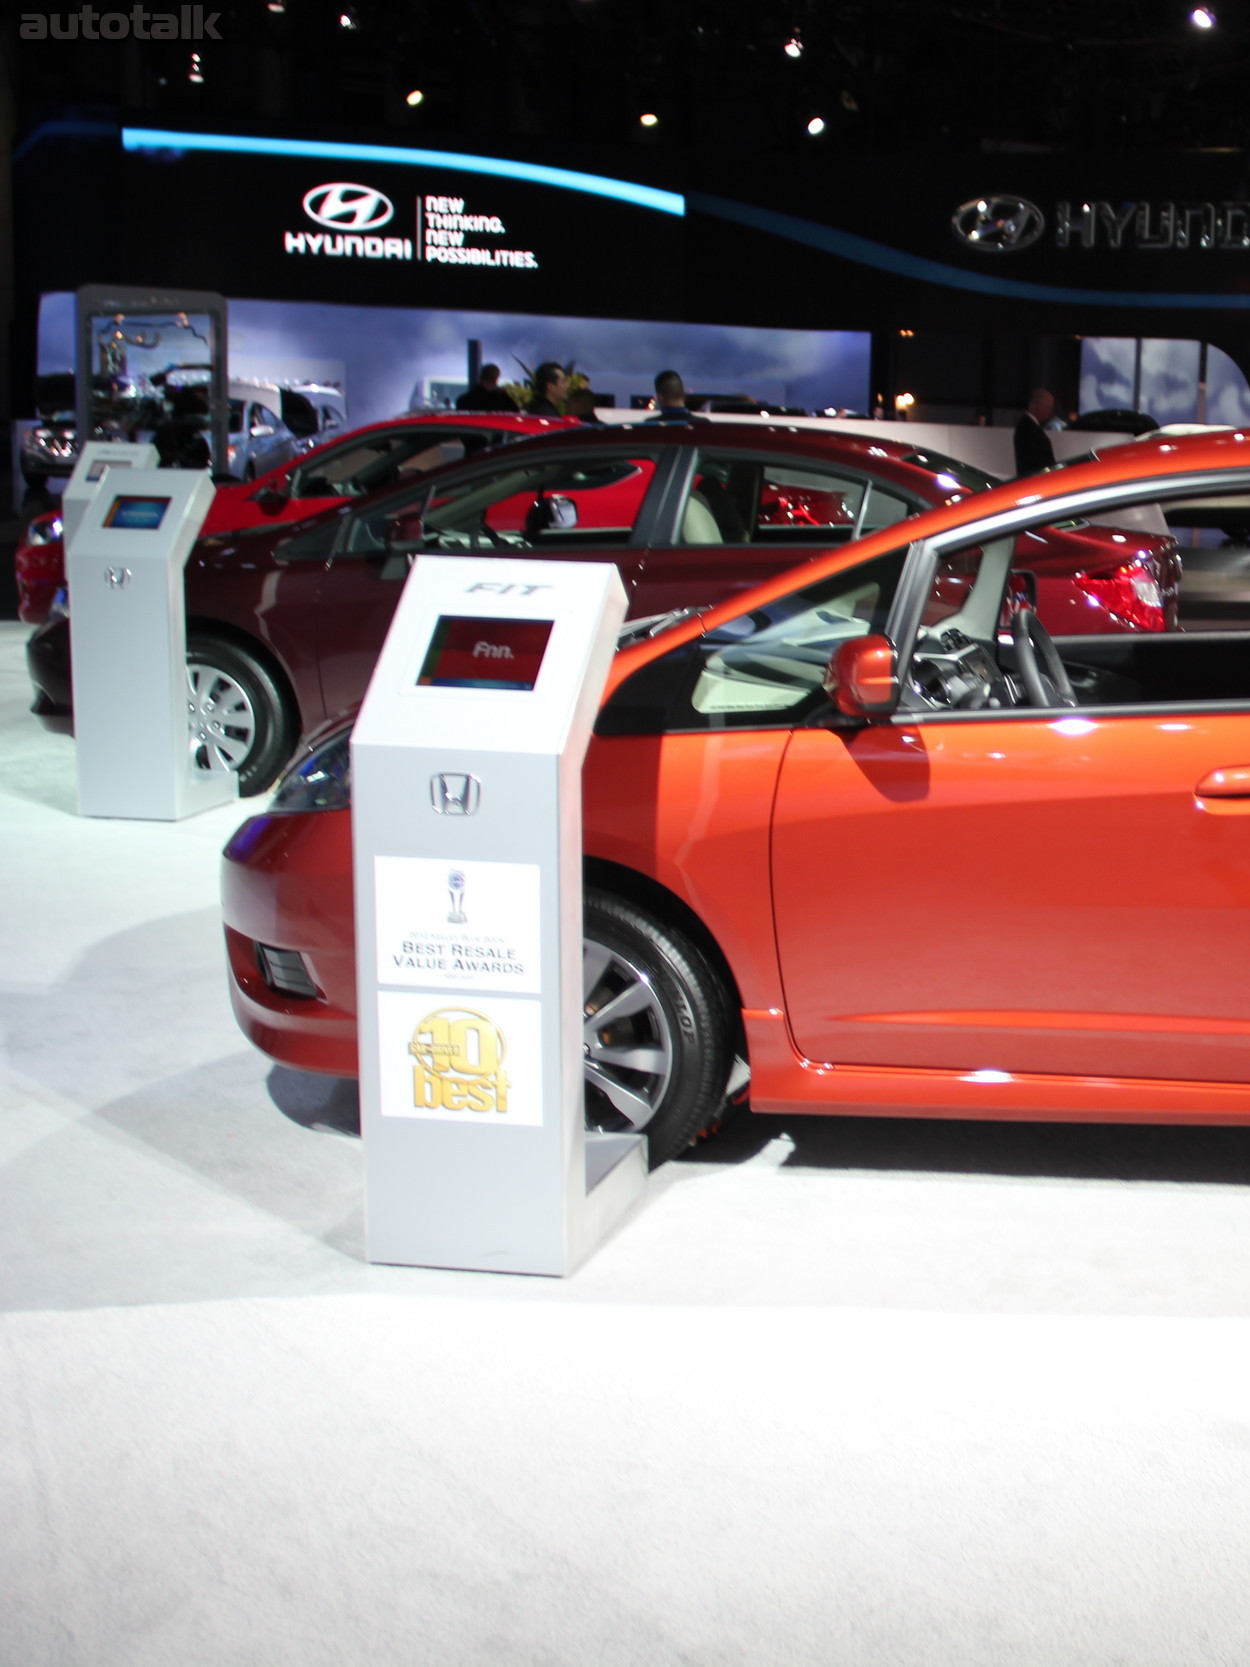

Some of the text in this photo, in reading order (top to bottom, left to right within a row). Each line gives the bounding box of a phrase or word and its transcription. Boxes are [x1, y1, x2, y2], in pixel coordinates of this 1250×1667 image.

[424, 195, 465, 215] NEW
[424, 212, 506, 234] THINKING.
[284, 230, 412, 261] HYUNDAI
[424, 228, 465, 248] NEW
[424, 245, 539, 269] POSSIBILITIES.
[464, 582, 554, 596] FIT
[402, 940, 517, 961] BEST RESALE
[392, 953, 447, 970] VALUE
[452, 958, 525, 976] AWARDS
[418, 1016, 502, 1076] 10
[413, 1063, 512, 1113] best
